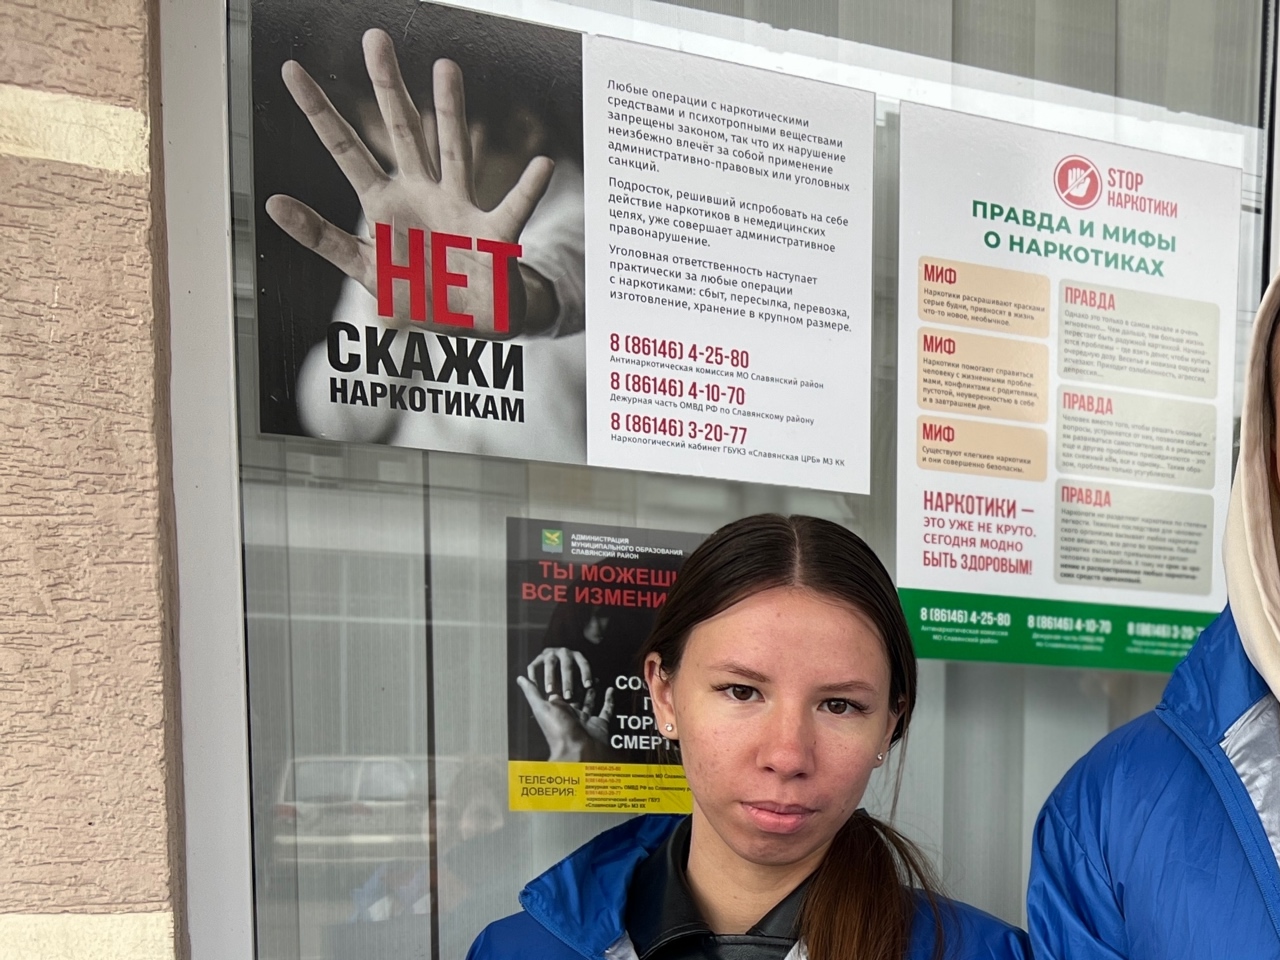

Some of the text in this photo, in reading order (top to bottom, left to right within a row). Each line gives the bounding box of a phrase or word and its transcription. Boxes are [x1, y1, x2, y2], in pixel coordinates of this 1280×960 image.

[606, 78, 809, 127] Любые операции с наркотическими
[607, 95, 842, 147] средствами и психотропными веществами
[607, 110, 846, 162] запрещены законом, так что их нарушение
[607, 125, 833, 174] неизбежно влечёт за собой применение
[607, 155, 660, 172] санкций.
[607, 140, 849, 191] административно-правовых или уголовных
[1107, 167, 1143, 192] STOP
[1107, 189, 1177, 218] НАРКОТИКИ
[971, 199, 1175, 251] ПРАВДА И МИФЫ
[608, 243, 817, 284] Уголовная ответственность наступает
[983, 230, 1163, 276] О НАРКОТИКАХ
[375, 222, 522, 333] НЕТ
[609, 260, 793, 295] практически за любые операции
[923, 263, 956, 284] МИФ
[608, 275, 849, 319] с наркотиками: сбыт, пересылка, перевозка,
[1064, 286, 1115, 310] ПРАВДА
[609, 290, 852, 332] изготовление, хранение в крупном размере.
[327, 321, 524, 392] СКАЖИ
[609, 332, 749, 368] 8 (86146) 4-25-80
[922, 333, 956, 355] МИФ
[609, 354, 824, 388] Антинаркотическая комиссия МО Славянский район
[330, 377, 525, 423] НАРКОТИКАМ
[610, 371, 745, 405] 8 (86146) 4-10-70
[1062, 391, 1113, 415] ПРАВДА
[610, 411, 747, 444] 8 (86146) 3-20-77
[922, 422, 955, 442] МИФ
[923, 489, 1016, 519] НАРКОТИКИ
[1060, 485, 1111, 507] ПРАВДА
[570, 533, 629, 544] АДМИНИСТРАЦИЯ
[923, 515, 1036, 538] ЭТО УЖЕ НЕ КРУТО.
[570, 540, 683, 555] МУНИЦИПАЛЬНОГО ОБРАЗОВАНИЯ
[570, 548, 639, 559] СЛАВЯНСКИЙ РАЙОН
[922, 532, 1023, 552] СЕГОДНЯ МОДНО
[538, 560, 574, 578] ТЫ
[922, 549, 1032, 574] БЫТЬ ЗДОРОВЫМ!
[522, 583, 667, 607] ВСЕ ИЗМЕНИ
[919, 606, 1011, 626] 8 (86146) 4-25-80
[610, 734, 671, 750] СМЕРТ
[518, 774, 580, 785] ТЕЛЕФОНЫ
[520, 786, 577, 797] ДОВЕРИЯ:
